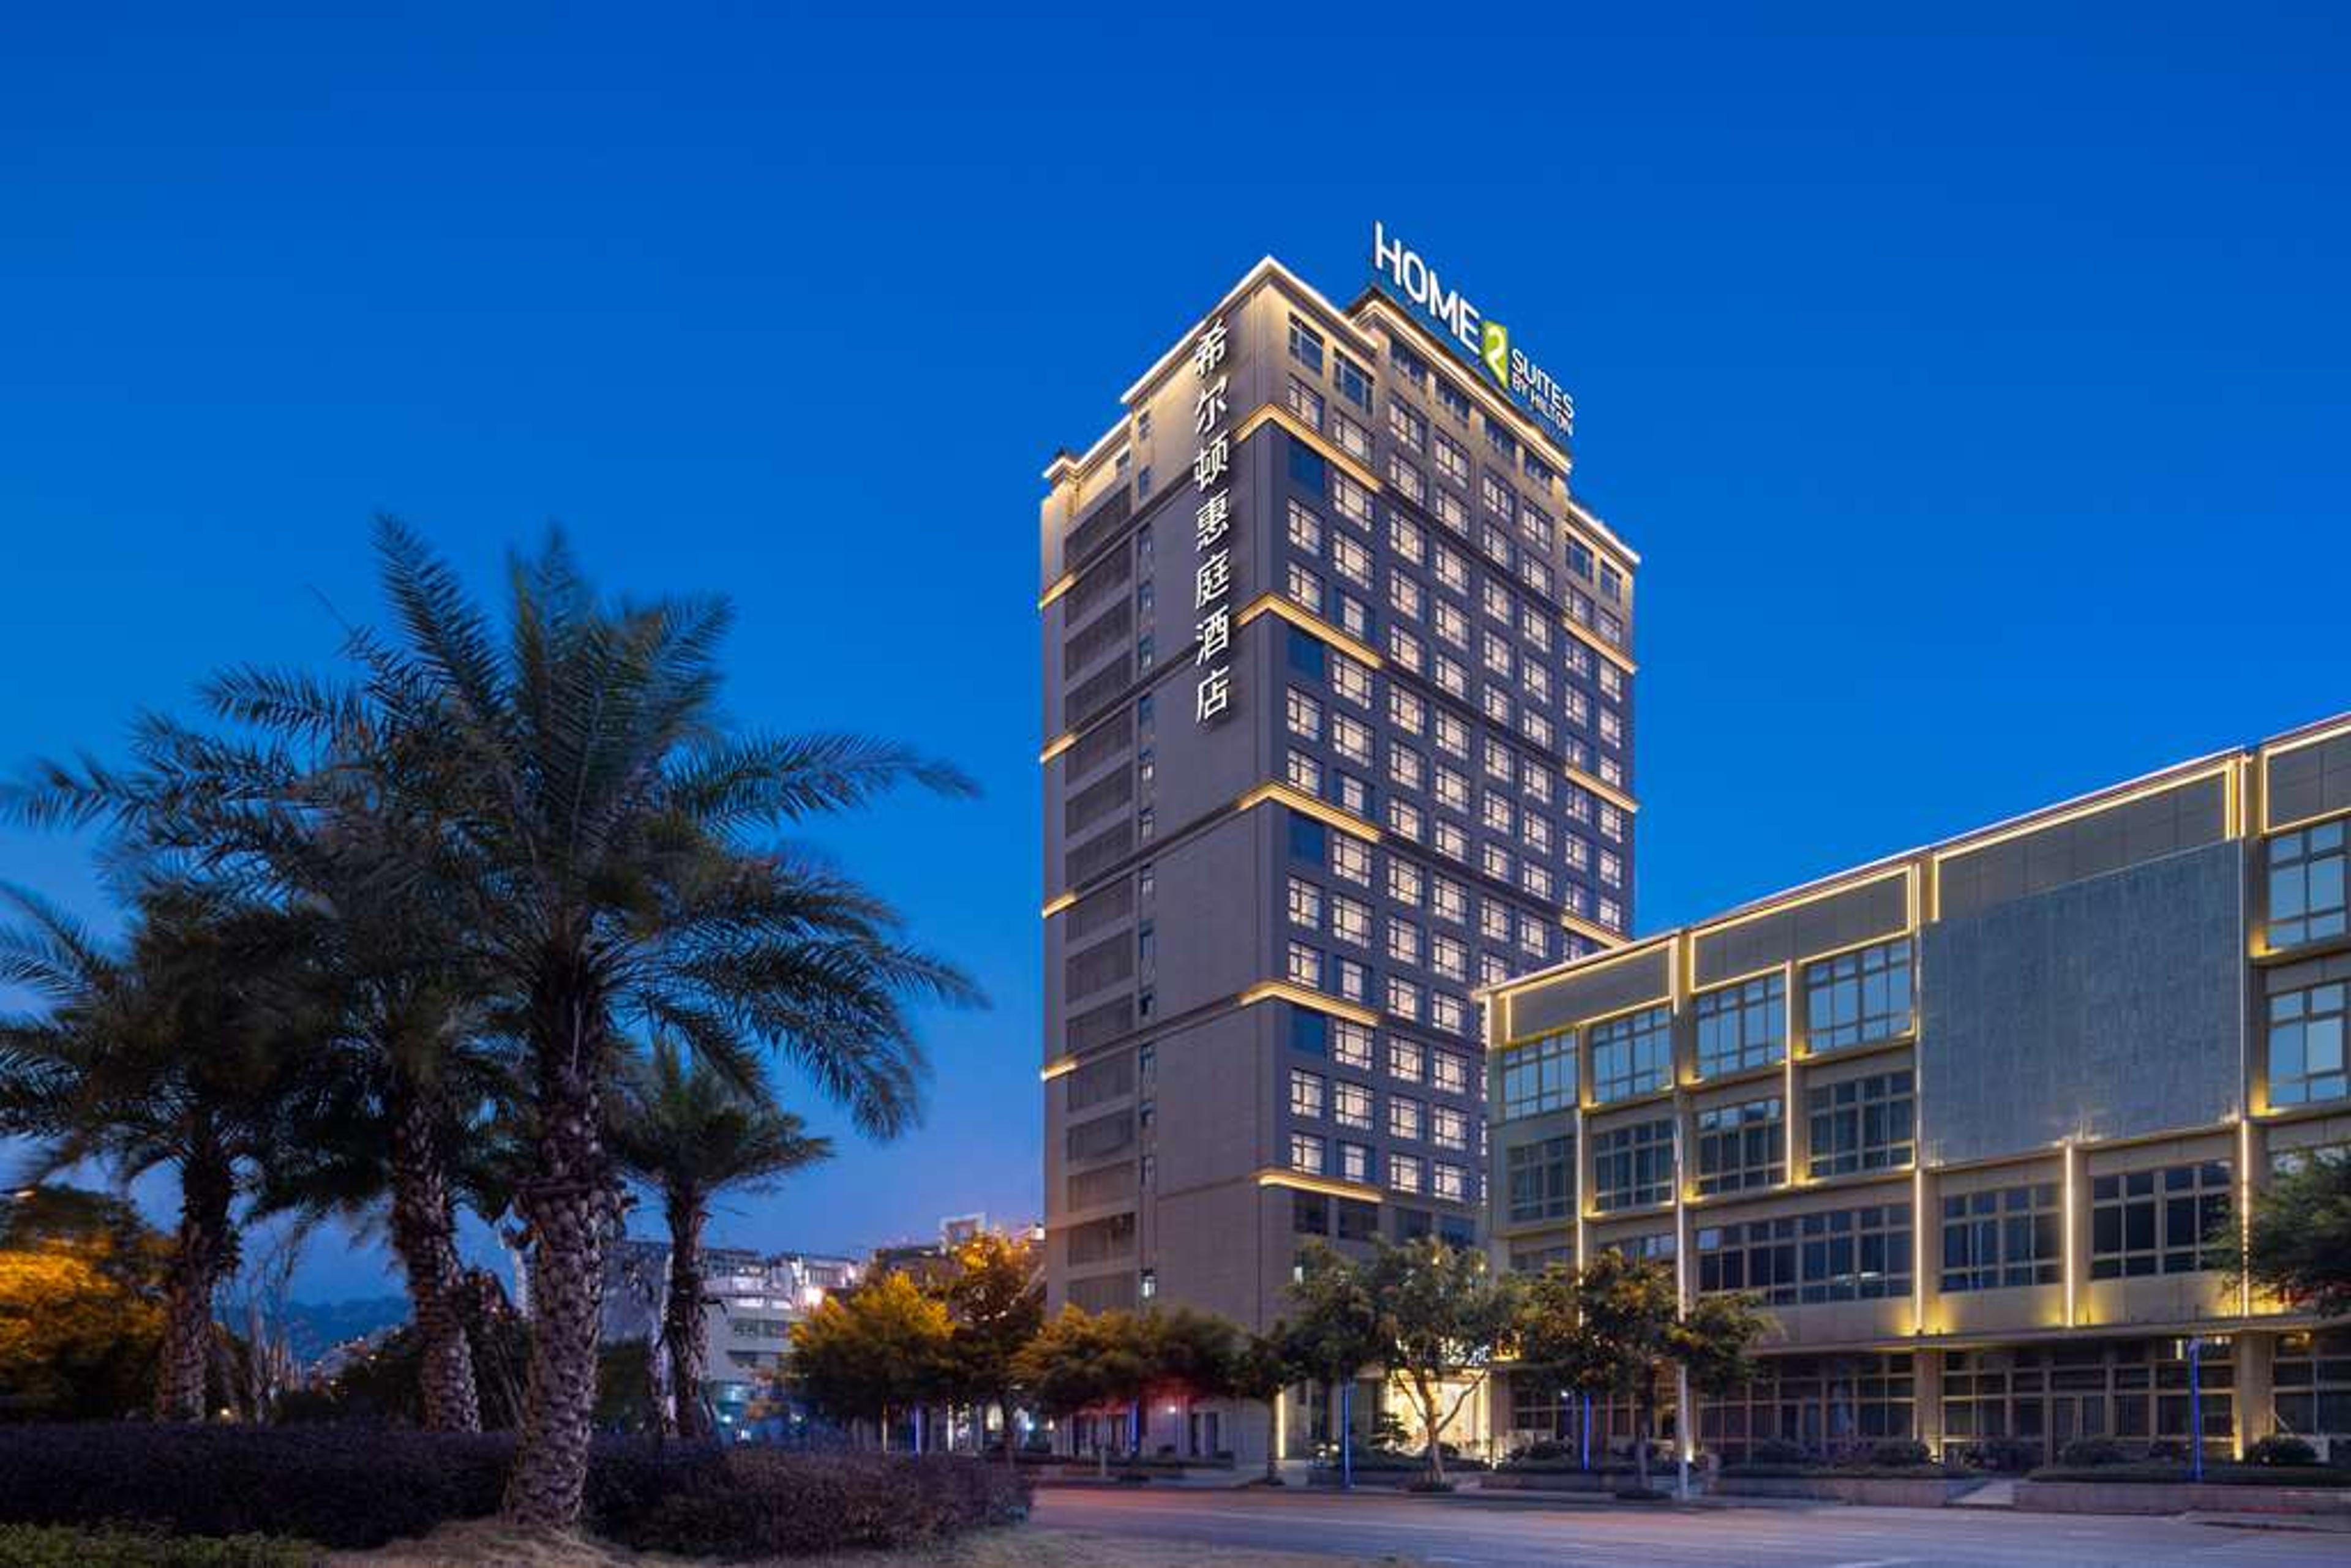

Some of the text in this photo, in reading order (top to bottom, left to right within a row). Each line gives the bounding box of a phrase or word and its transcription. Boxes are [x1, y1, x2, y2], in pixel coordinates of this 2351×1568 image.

[1374, 220, 1507, 387] HOME 2
[1512, 348, 1575, 419] SUITES
[1194, 320, 1229, 724] 希尔顿惠庭酒店
